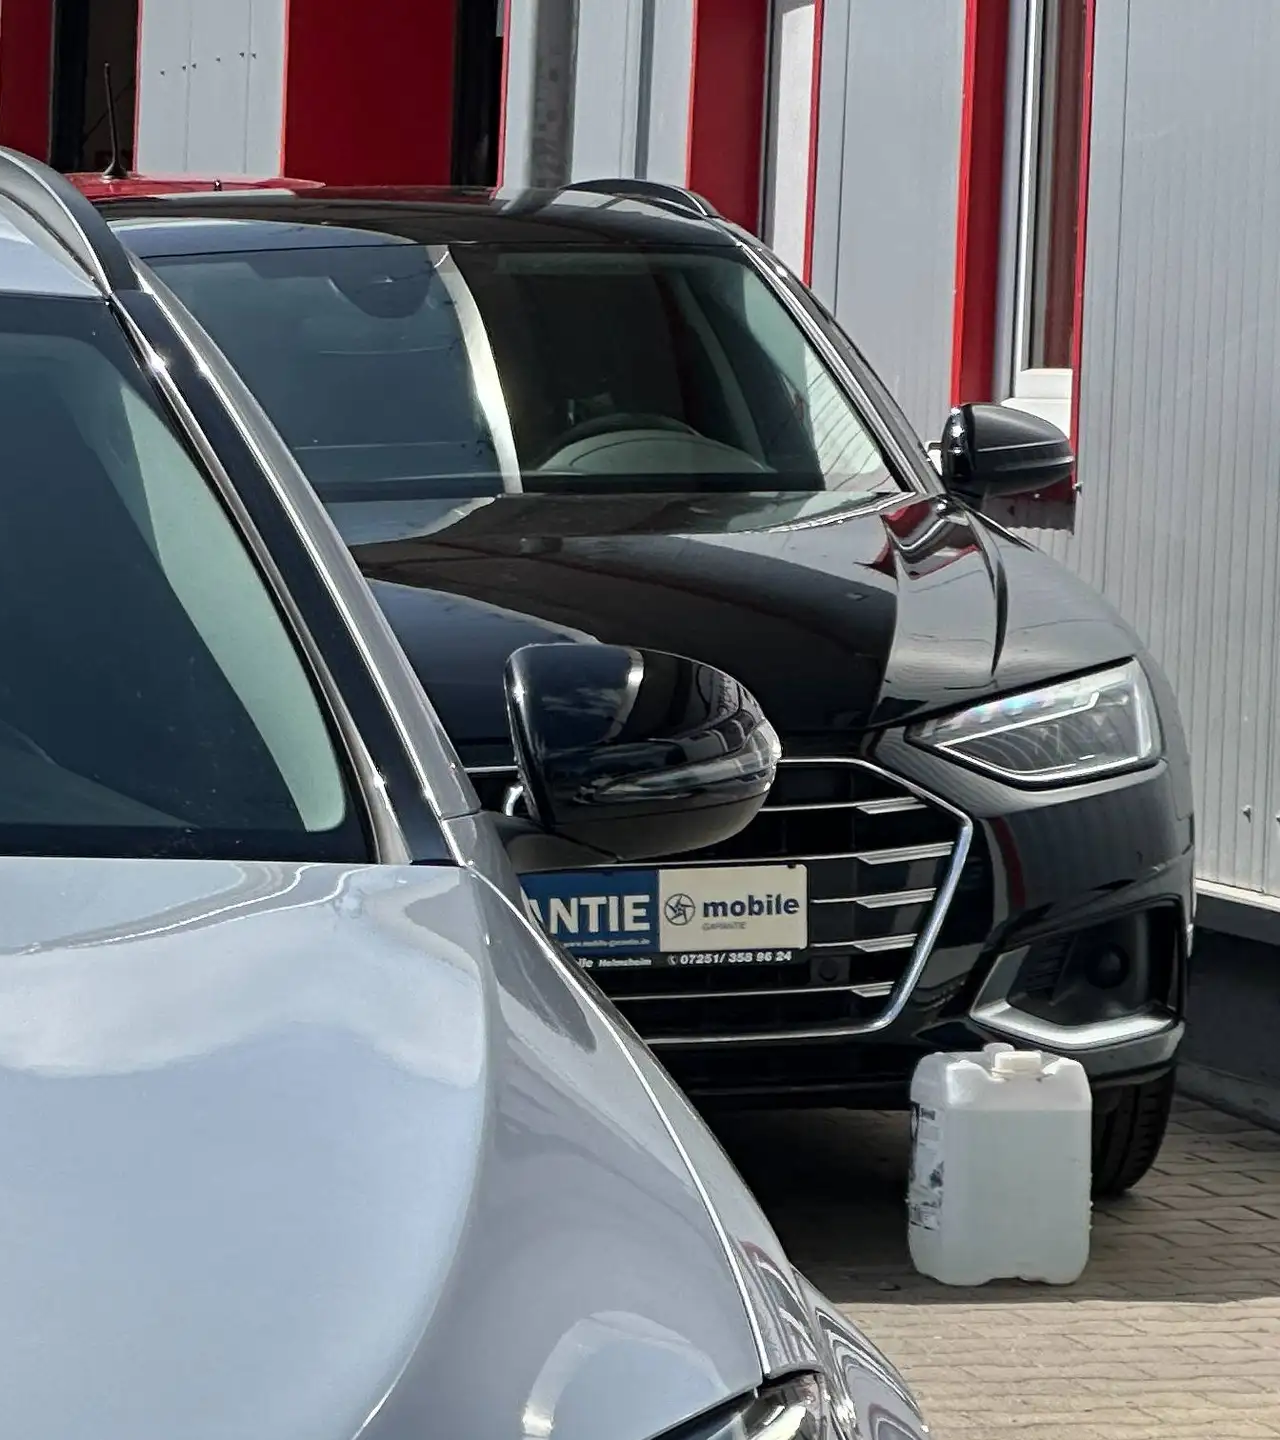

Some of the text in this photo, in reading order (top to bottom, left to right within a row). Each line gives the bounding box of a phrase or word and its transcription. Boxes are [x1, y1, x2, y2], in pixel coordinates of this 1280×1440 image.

[702, 893, 800, 918] mobile
[680, 952, 727, 965] 07251/
[775, 950, 792, 961] 24
